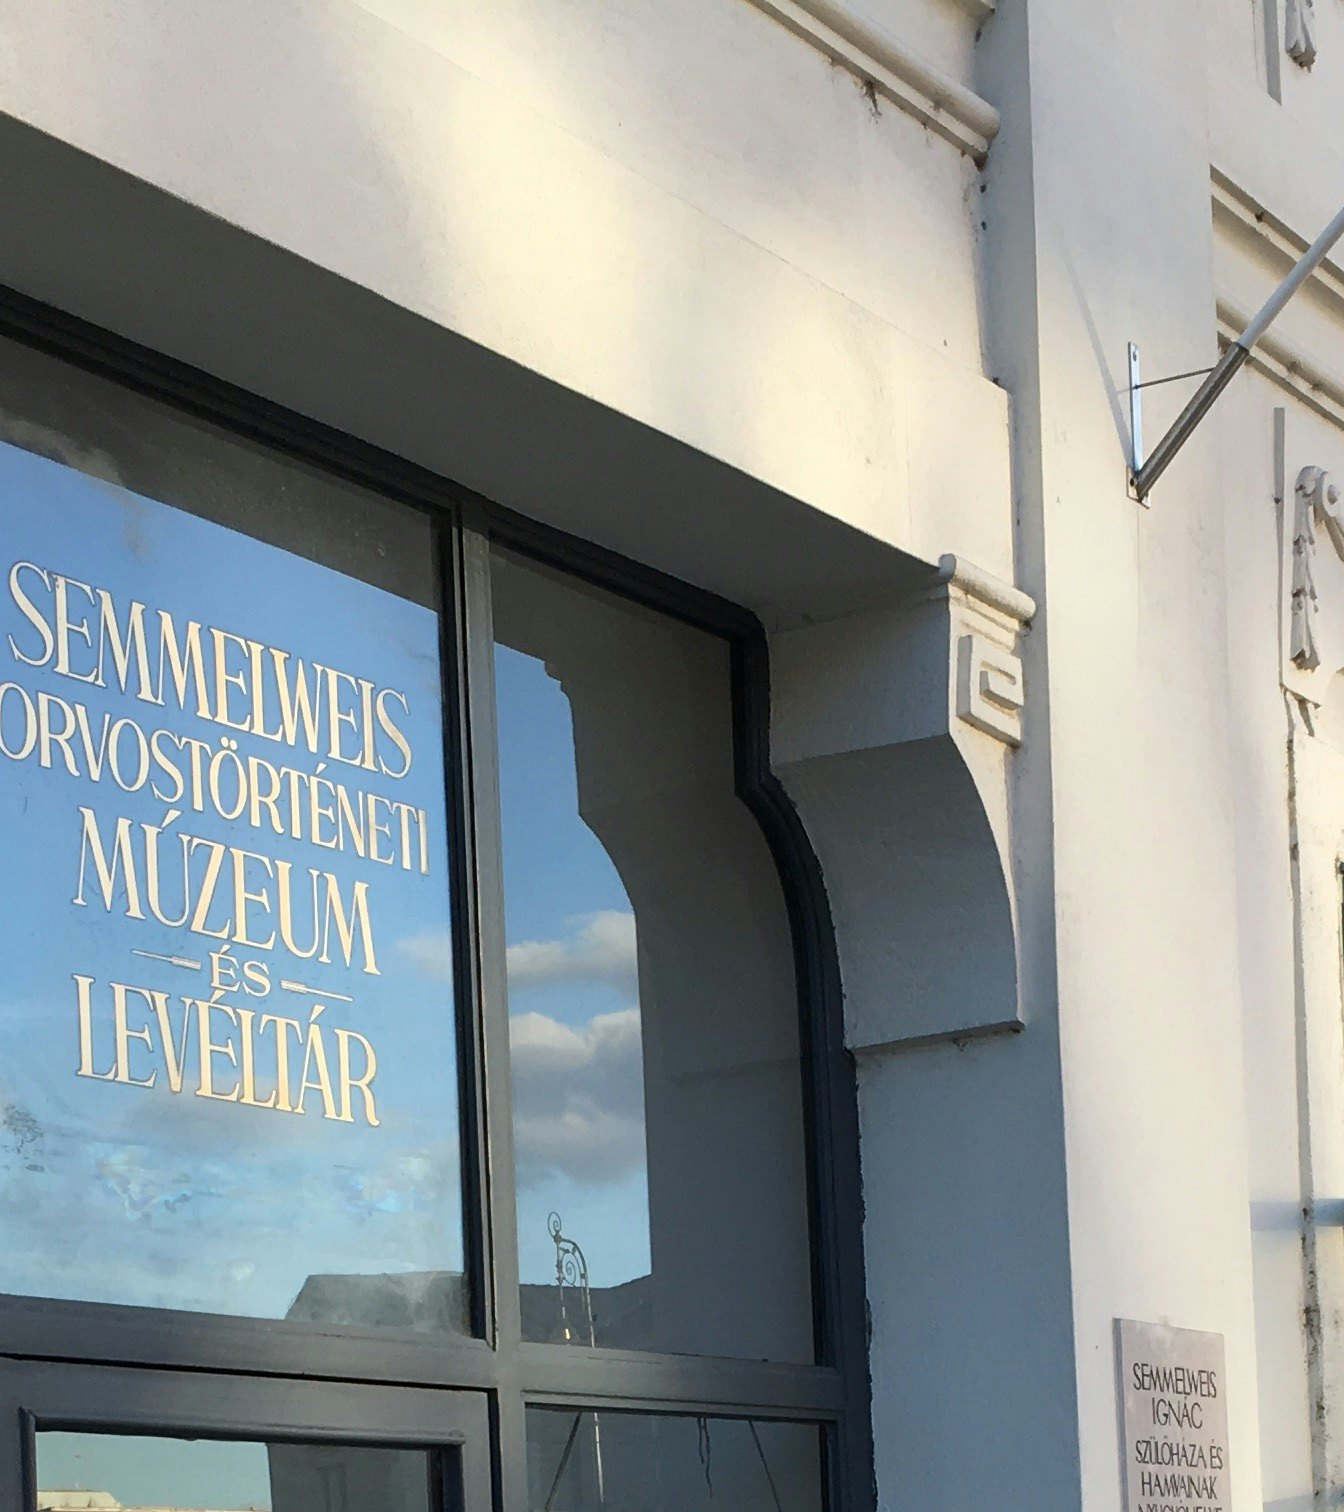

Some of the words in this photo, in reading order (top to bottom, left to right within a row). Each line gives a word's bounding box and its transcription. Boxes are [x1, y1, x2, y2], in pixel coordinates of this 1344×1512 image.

[8, 560, 412, 778] SEMMELWEIS
[72, 806, 380, 975] MÚZEUM
[209, 946, 271, 997] ÉS
[73, 975, 380, 1126] LEVÉLTÁR
[1133, 1362, 1217, 1399] SEMMELWEIS
[1151, 1396, 1203, 1430] IGNÁC
[1209, 1438, 1224, 1470] ÉS
